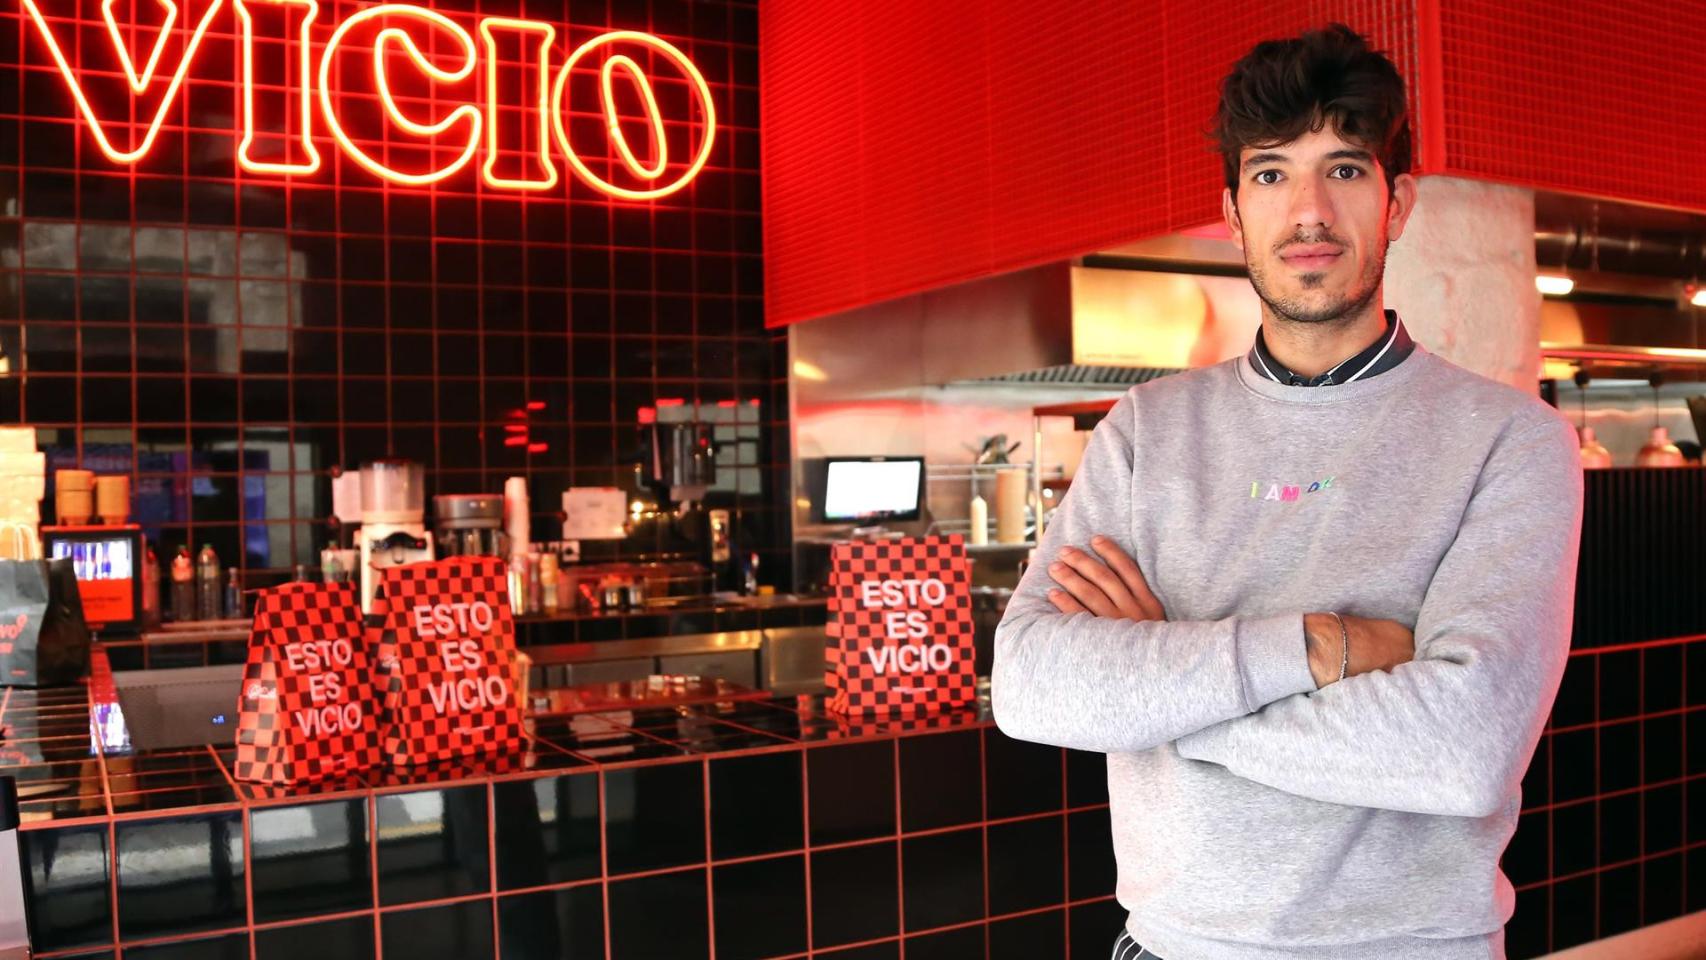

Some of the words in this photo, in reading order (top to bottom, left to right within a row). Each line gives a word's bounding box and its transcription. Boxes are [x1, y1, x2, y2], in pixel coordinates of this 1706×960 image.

[20, 0, 718, 200] VICIO
[1250, 481, 1258, 498] I
[1264, 484, 1300, 503] AM
[861, 579, 946, 607] ESTO
[413, 600, 493, 637] ESTO
[885, 612, 928, 639] ES
[284, 638, 352, 671] ESTO
[440, 640, 482, 672] ES
[866, 643, 952, 673] VICIO
[308, 672, 341, 702] ES
[427, 674, 508, 714] VICIO
[295, 702, 362, 737] VICIO
